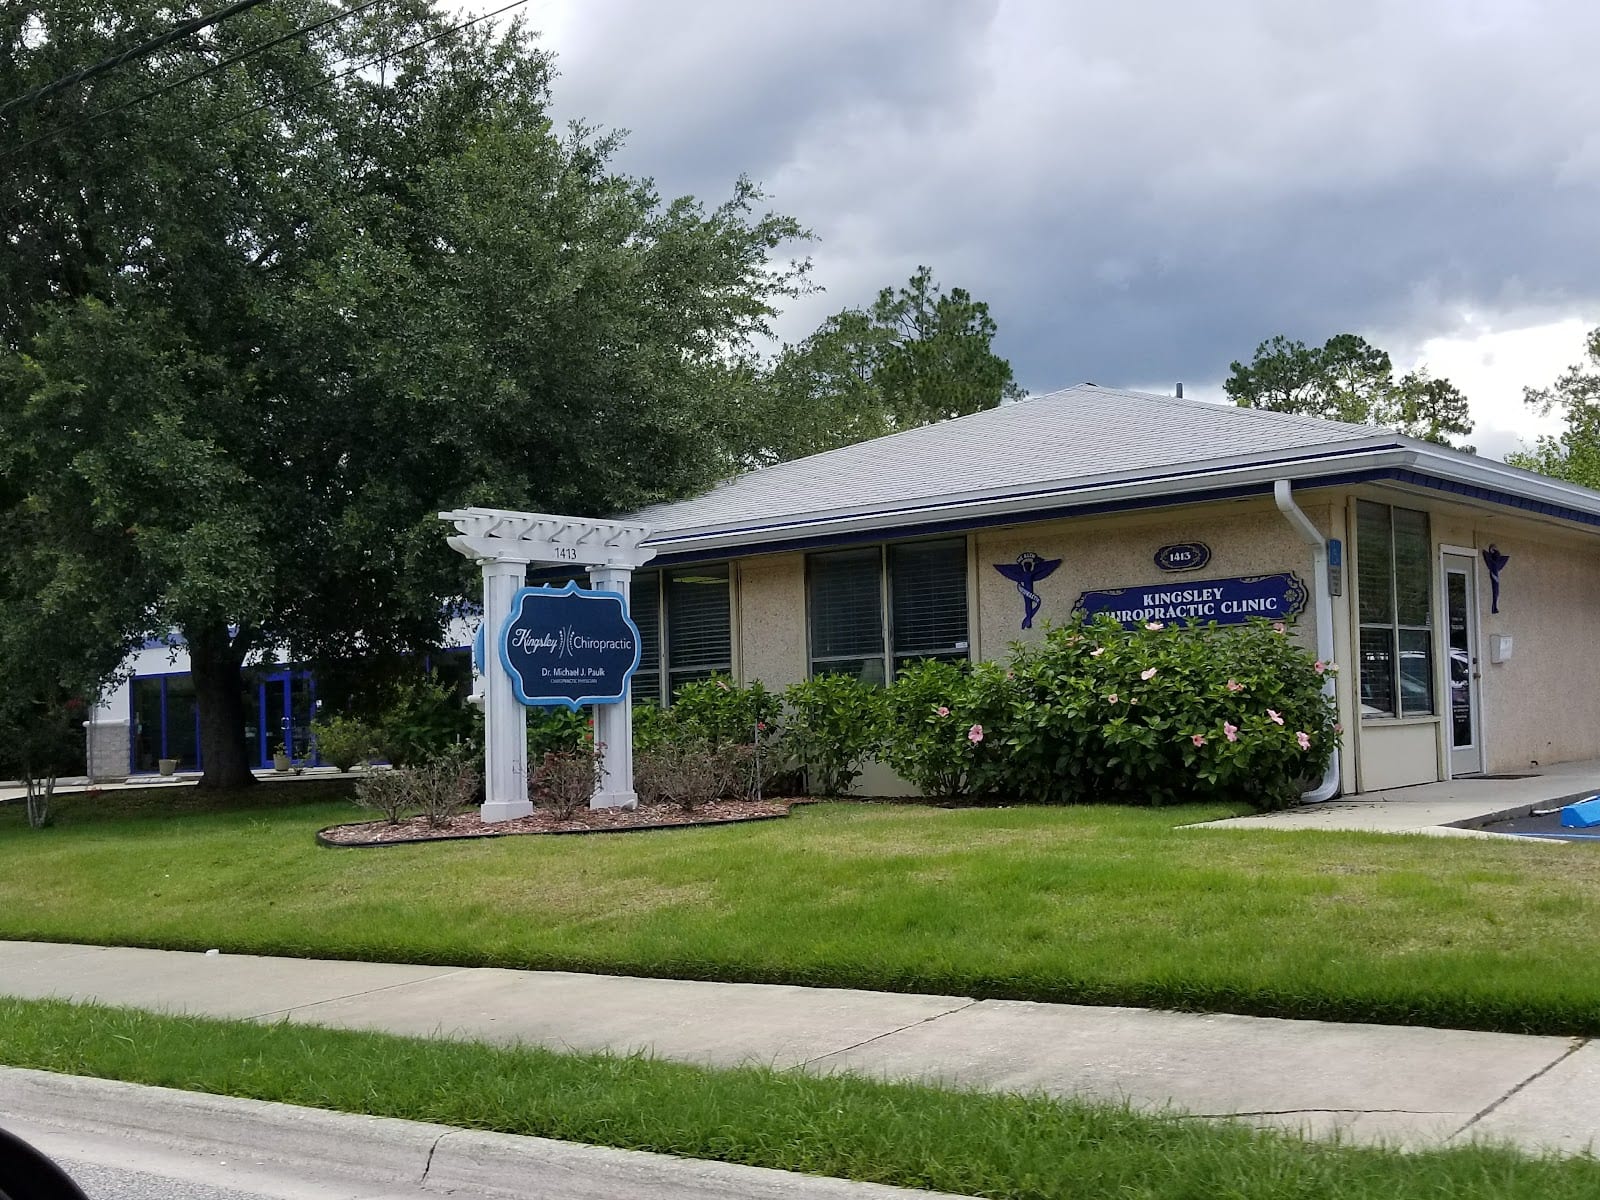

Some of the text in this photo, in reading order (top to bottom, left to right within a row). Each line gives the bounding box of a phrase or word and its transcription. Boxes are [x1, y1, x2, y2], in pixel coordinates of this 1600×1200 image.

[555, 547, 577, 559] 1413
[1169, 551, 1191, 562] 1413
[1143, 588, 1222, 606] KINGSLEY
[1222, 598, 1277, 613] CLINIC
[512, 628, 632, 654] Kingsley Chiropractic
[542, 667, 605, 677] Dr. Michael J. Paulk
